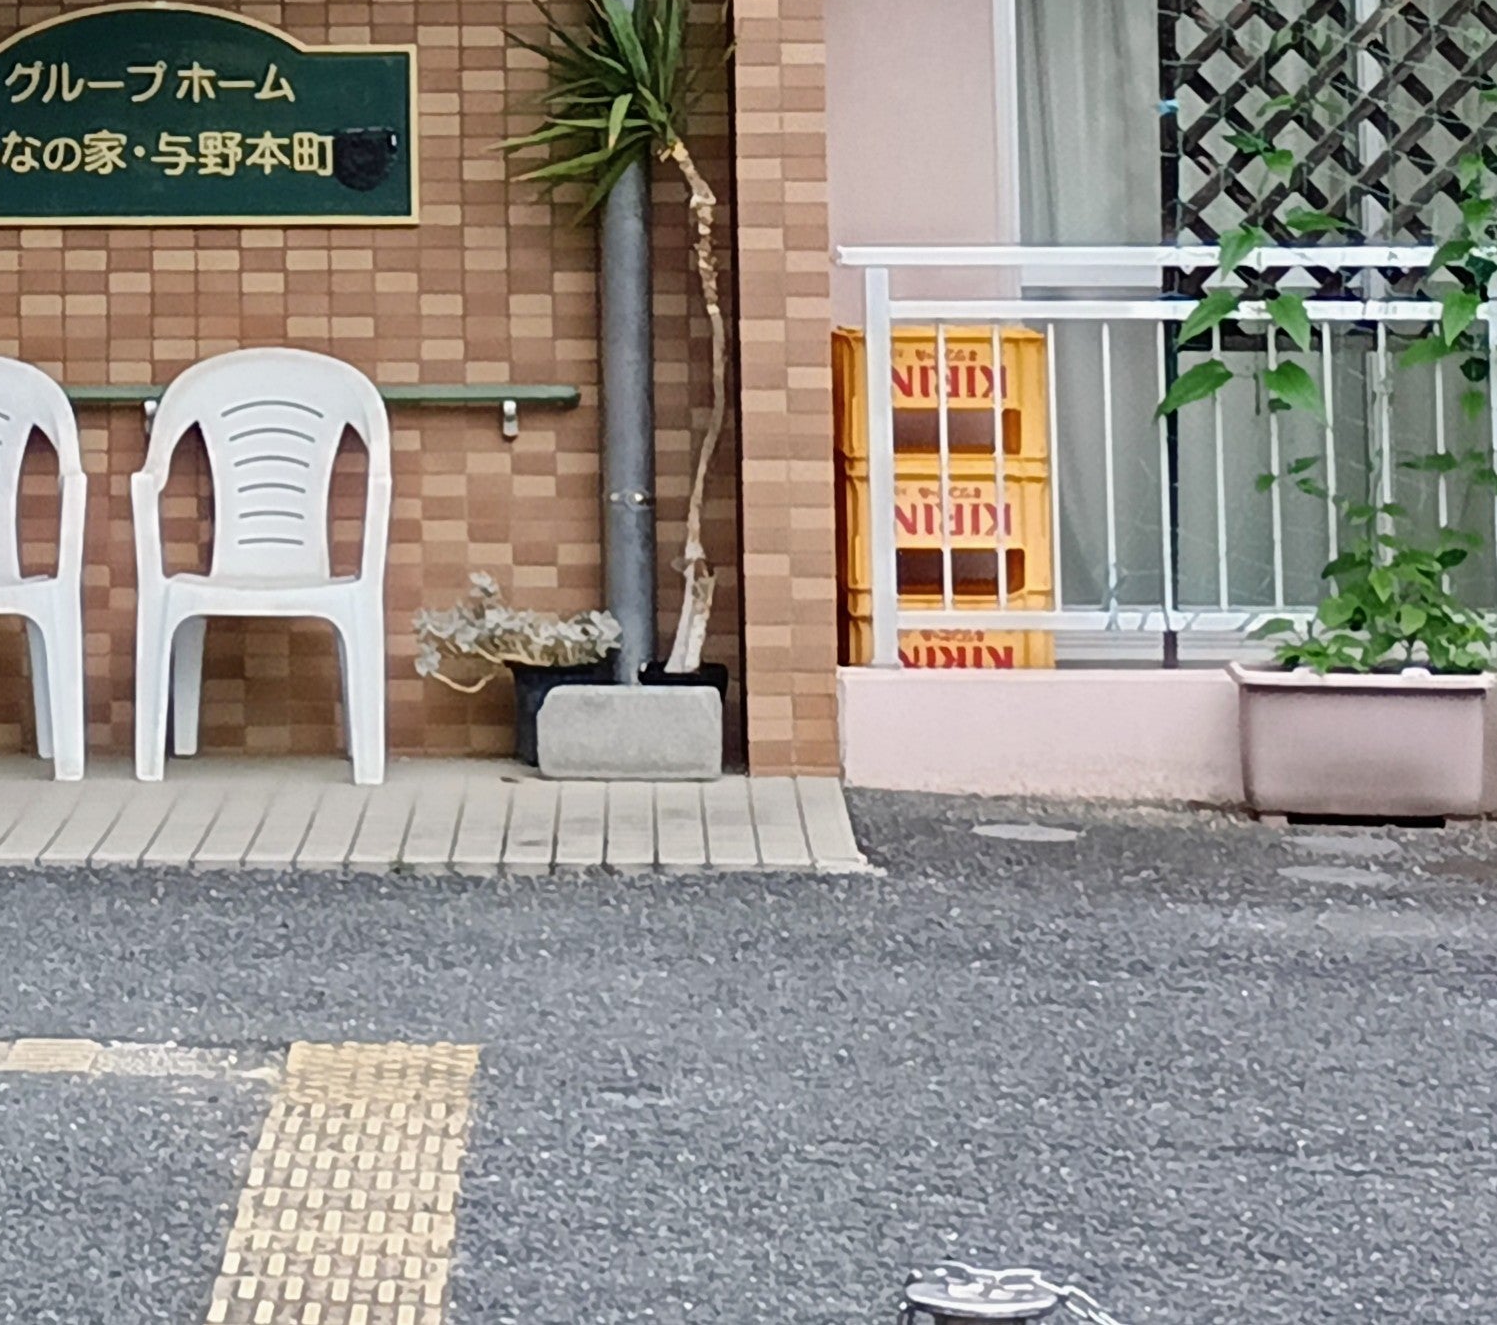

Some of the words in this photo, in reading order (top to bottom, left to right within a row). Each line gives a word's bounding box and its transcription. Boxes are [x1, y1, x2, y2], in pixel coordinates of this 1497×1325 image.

[4, 61, 295, 103] グループホーム
